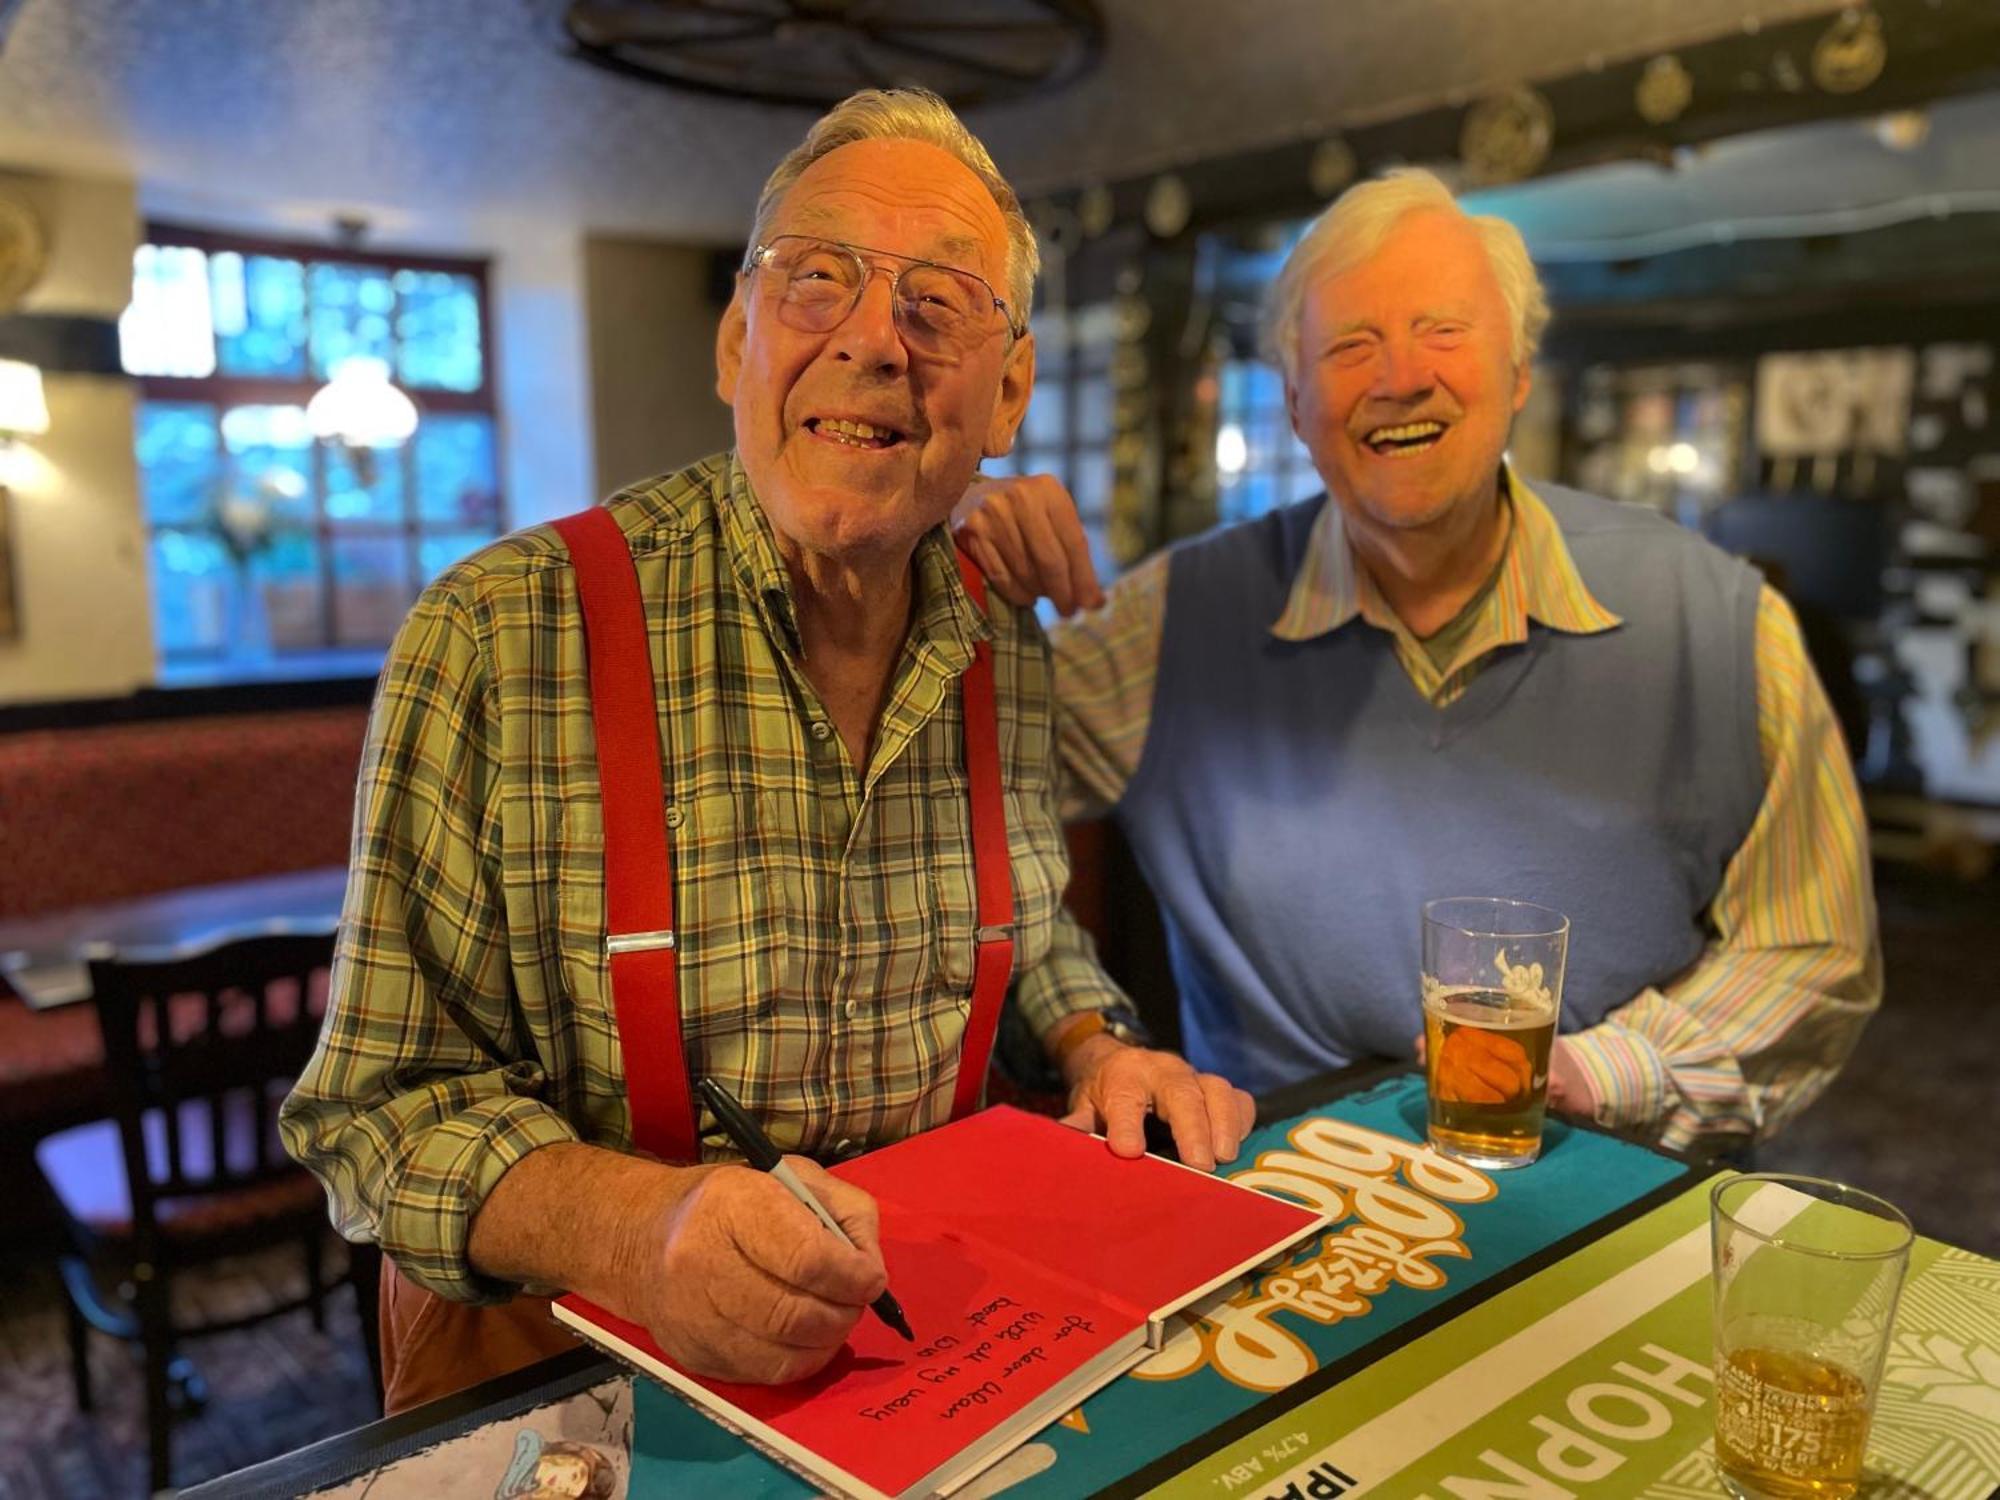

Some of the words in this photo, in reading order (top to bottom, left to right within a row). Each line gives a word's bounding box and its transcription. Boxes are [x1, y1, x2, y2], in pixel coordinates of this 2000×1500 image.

[966, 1297, 1022, 1327] best
[963, 1341, 992, 1364] all
[859, 1387, 926, 1422] very
[1263, 1431, 1310, 1463] 4.7%
[1769, 1423, 1822, 1453] 175
